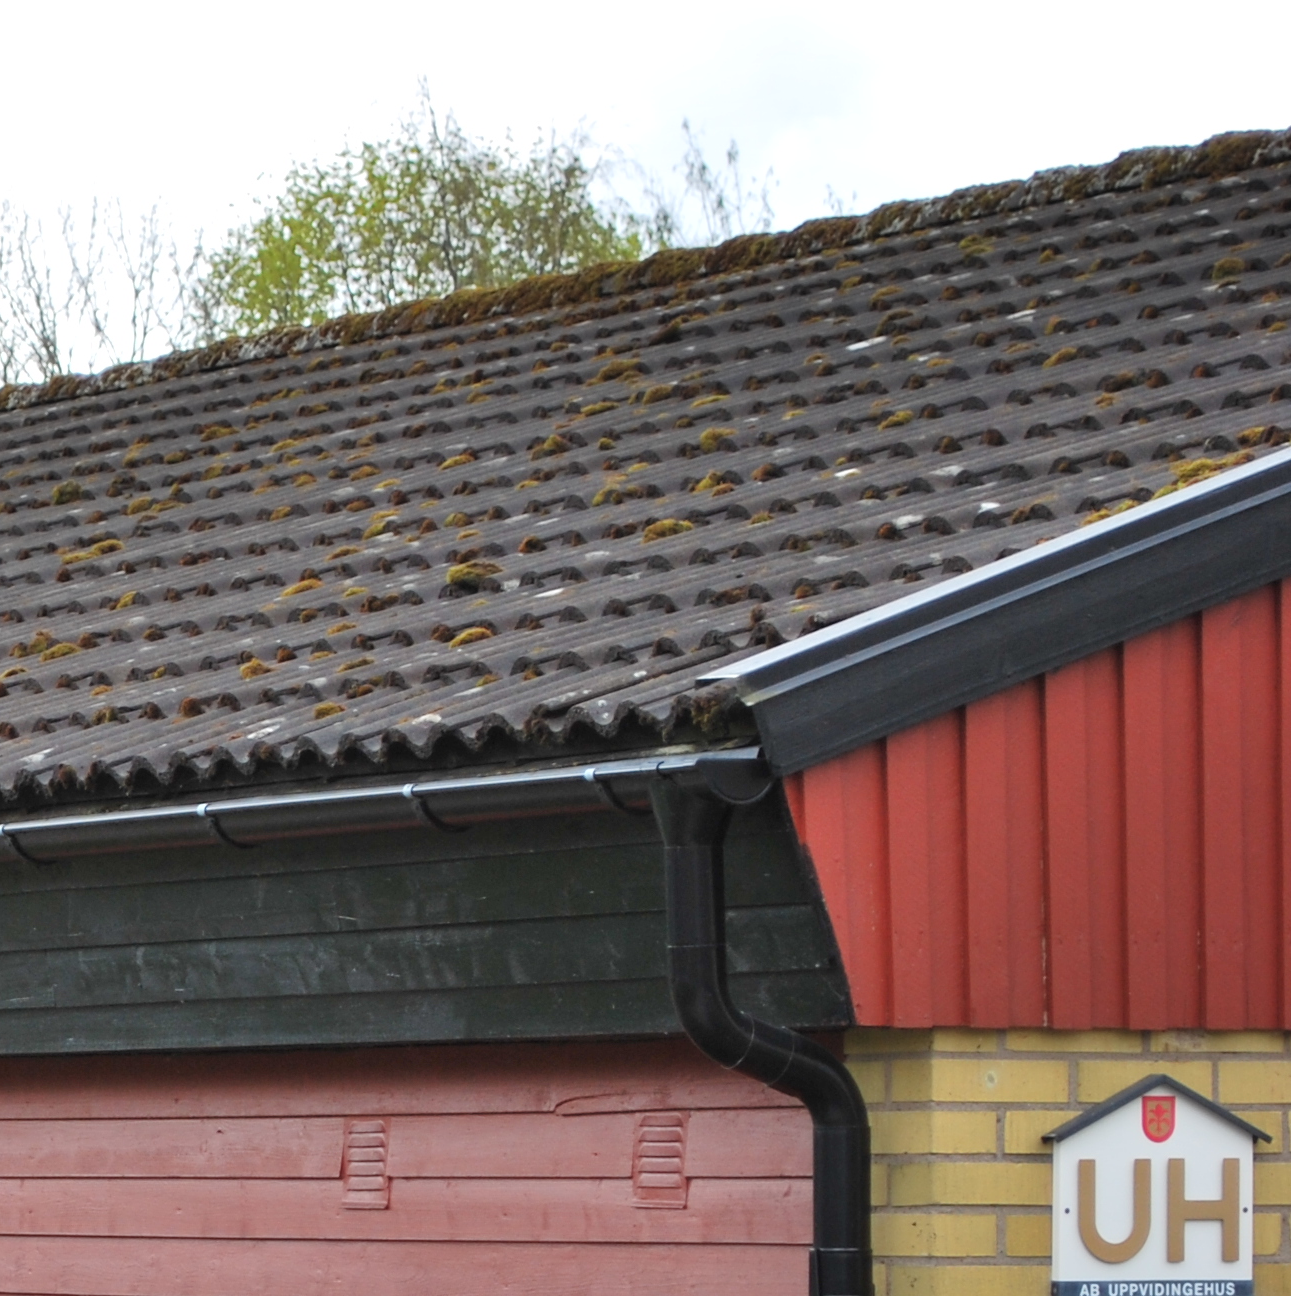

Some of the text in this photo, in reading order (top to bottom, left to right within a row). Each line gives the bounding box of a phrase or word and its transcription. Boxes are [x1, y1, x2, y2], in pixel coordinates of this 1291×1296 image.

[1078, 1158, 1240, 1264] UH
[1079, 1282, 1236, 1296] AB UPPVIDINGEHUS
